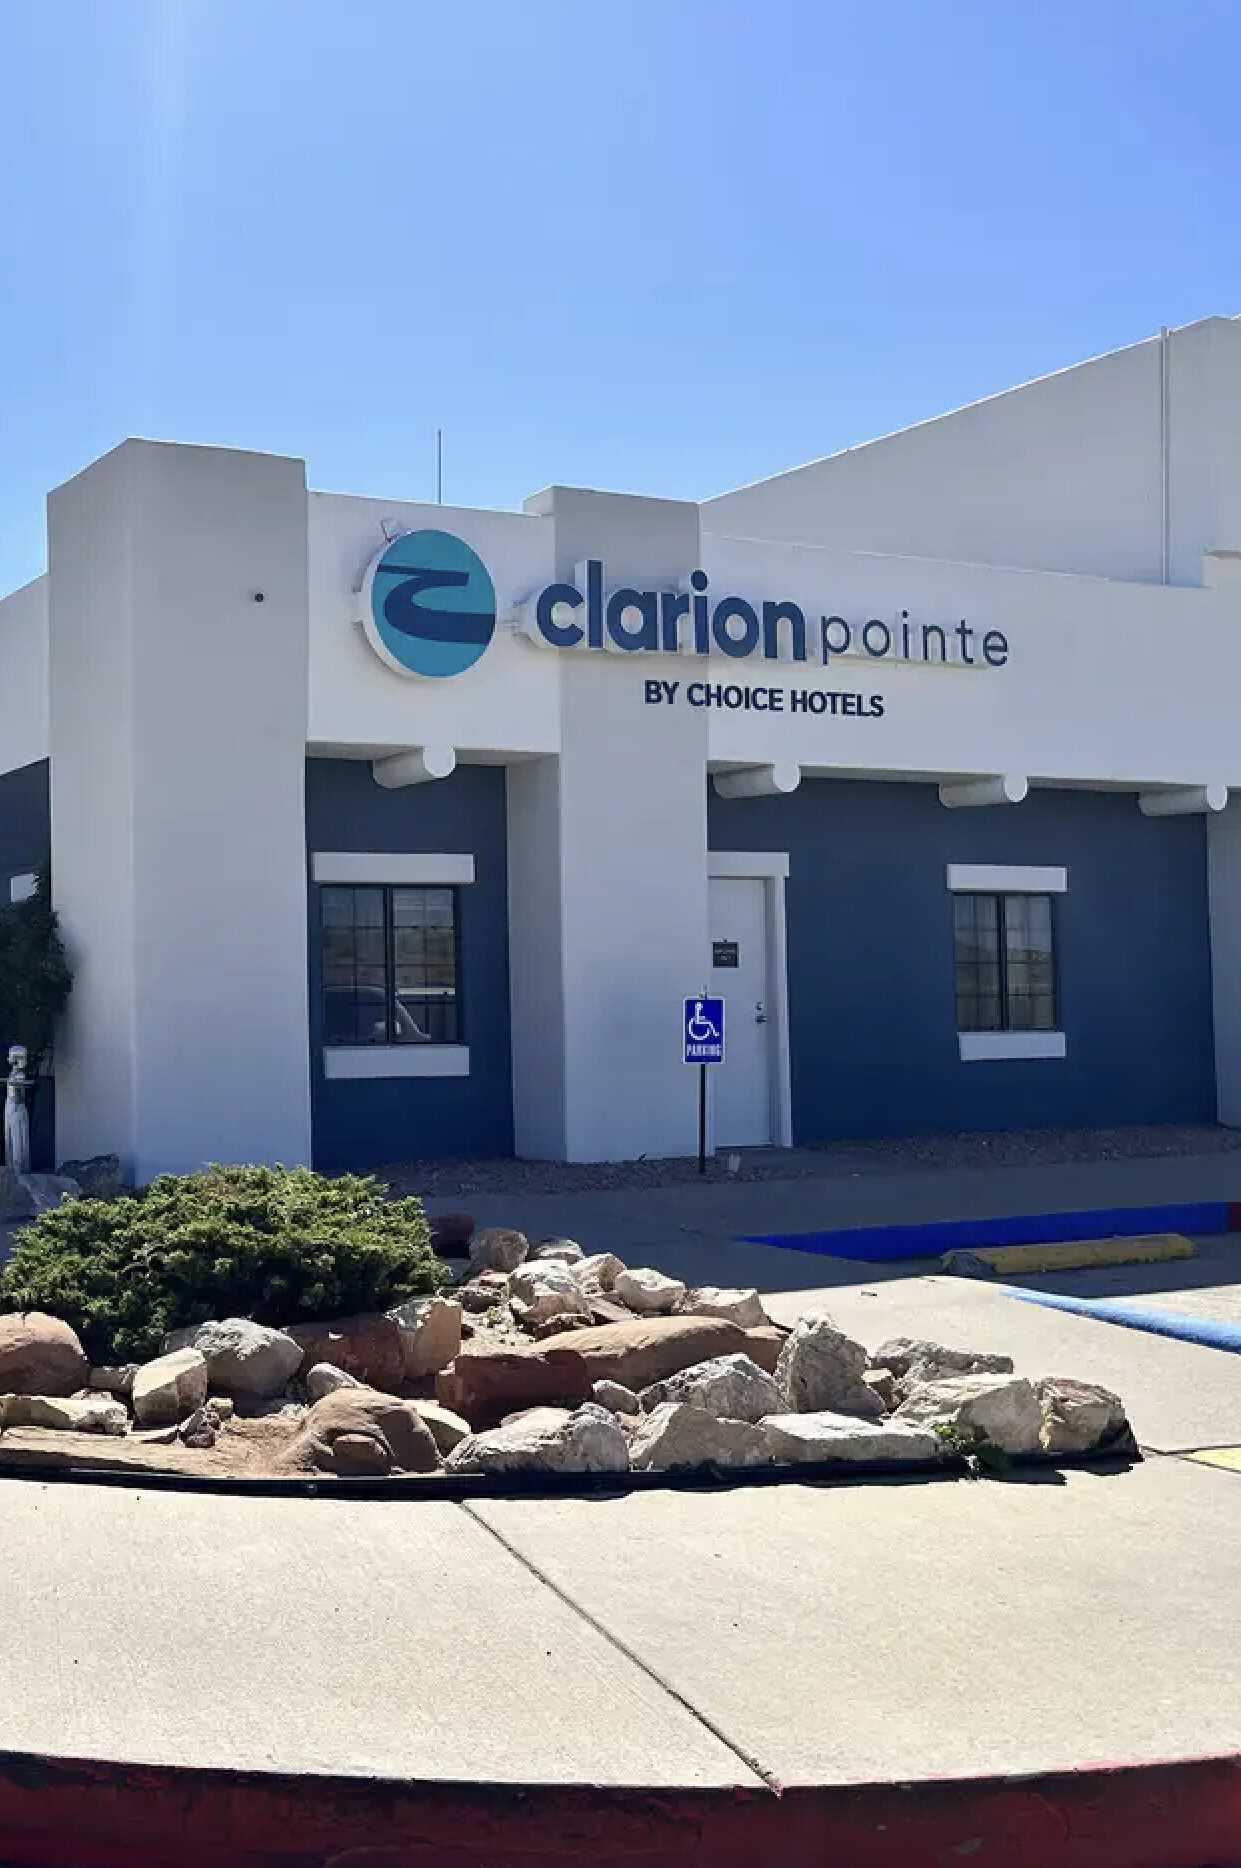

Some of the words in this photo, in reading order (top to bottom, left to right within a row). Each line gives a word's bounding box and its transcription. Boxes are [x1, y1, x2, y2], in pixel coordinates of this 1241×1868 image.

[537, 560, 807, 661] clarion
[821, 609, 1009, 667] pointe
[644, 679, 679, 704] BY
[687, 683, 783, 712] CHOICE
[791, 689, 885, 717] HOTELS
[687, 1043, 722, 1057] PARKING
